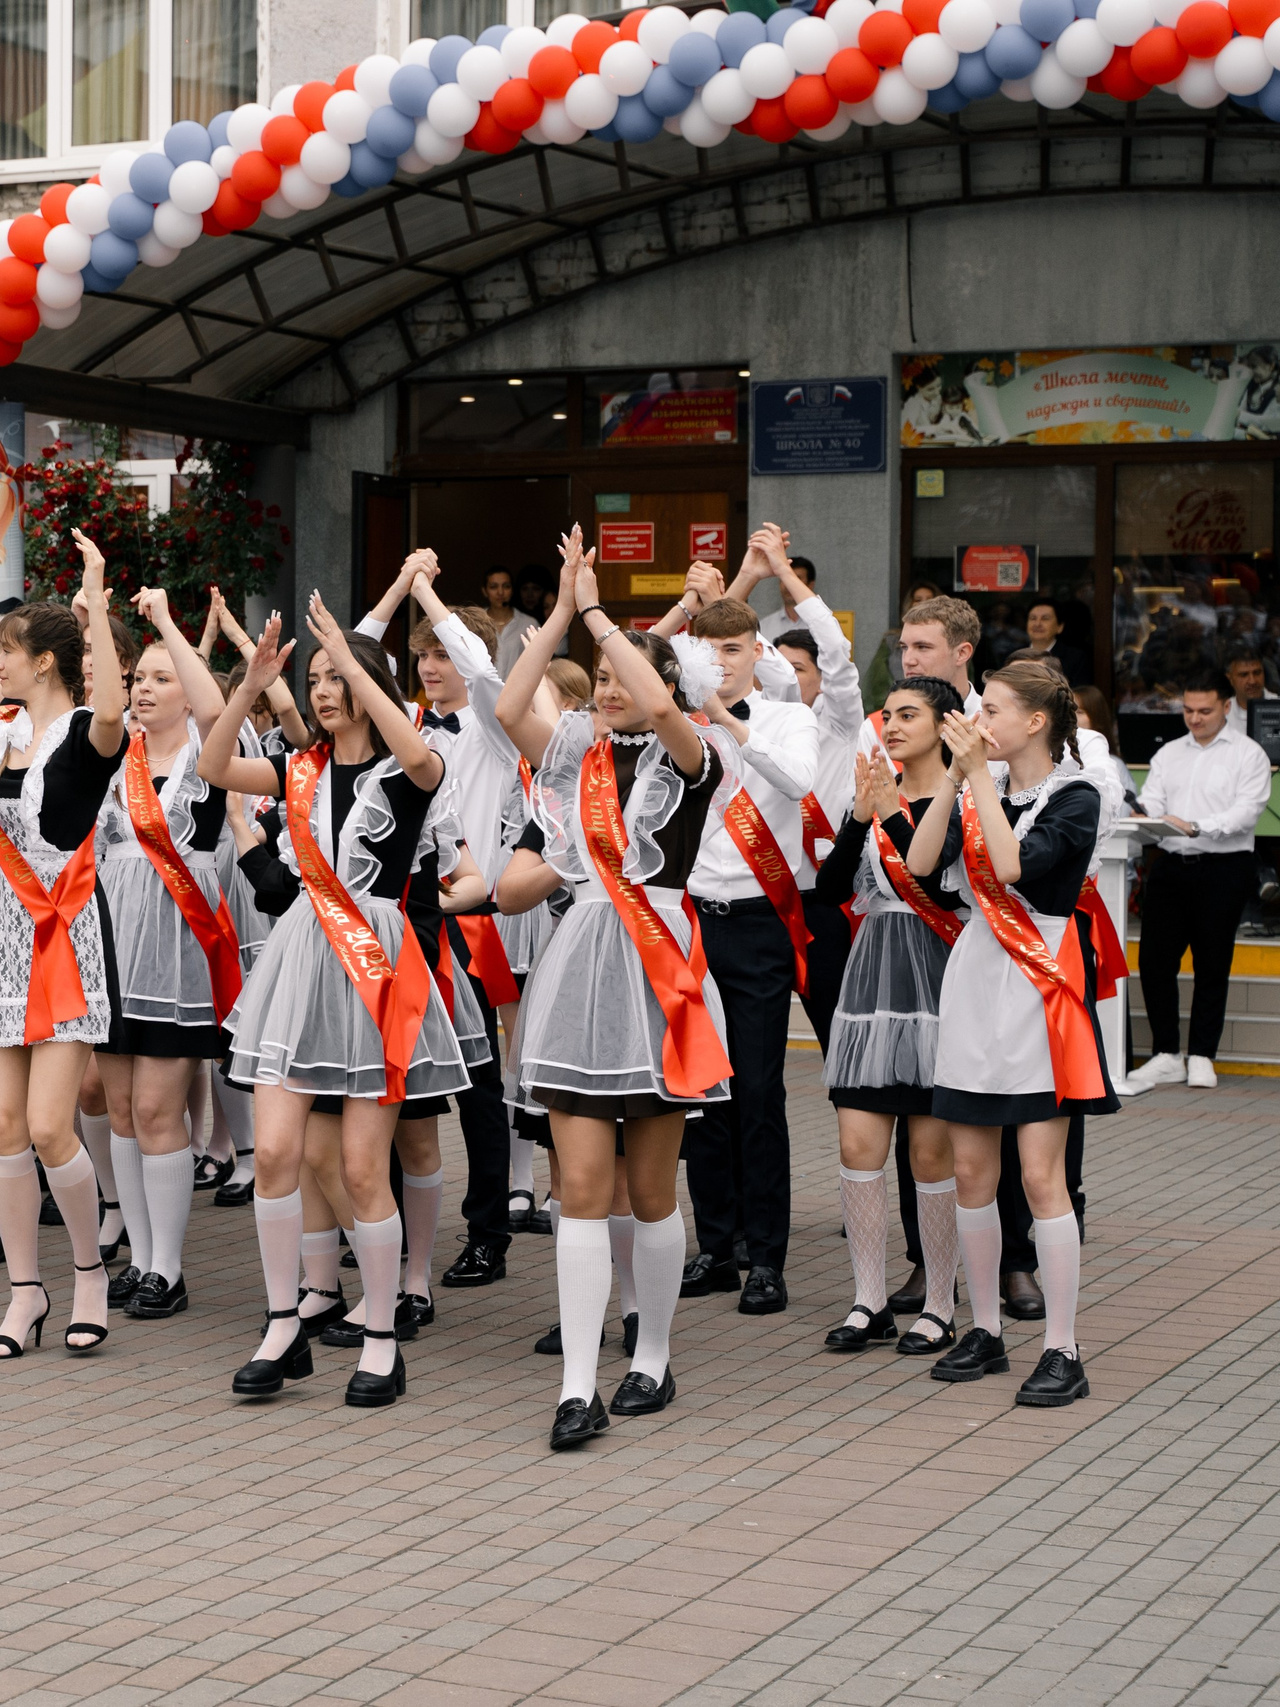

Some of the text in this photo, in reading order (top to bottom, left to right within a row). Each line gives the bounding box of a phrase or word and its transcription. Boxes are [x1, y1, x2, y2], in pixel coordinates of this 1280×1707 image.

[1033, 370, 1169, 392] «Школа мечты,
[652, 408, 732, 418] ИЗБИРАТЕЛЬНАЯ
[660, 396, 724, 407] УЧАСТКОВАЯ
[1026, 393, 1191, 420] надежды и свершений!»
[664, 419, 719, 429] КОМИССИЯ
[776, 439, 823, 451] ШКОЛА
[845, 438, 861, 449] 40
[586, 755, 638, 906] Выпускница
[605, 797, 626, 857] Письменная
[742, 805, 763, 831] Артём
[752, 846, 788, 880] 2026
[290, 799, 392, 982] Выпускница 2026
